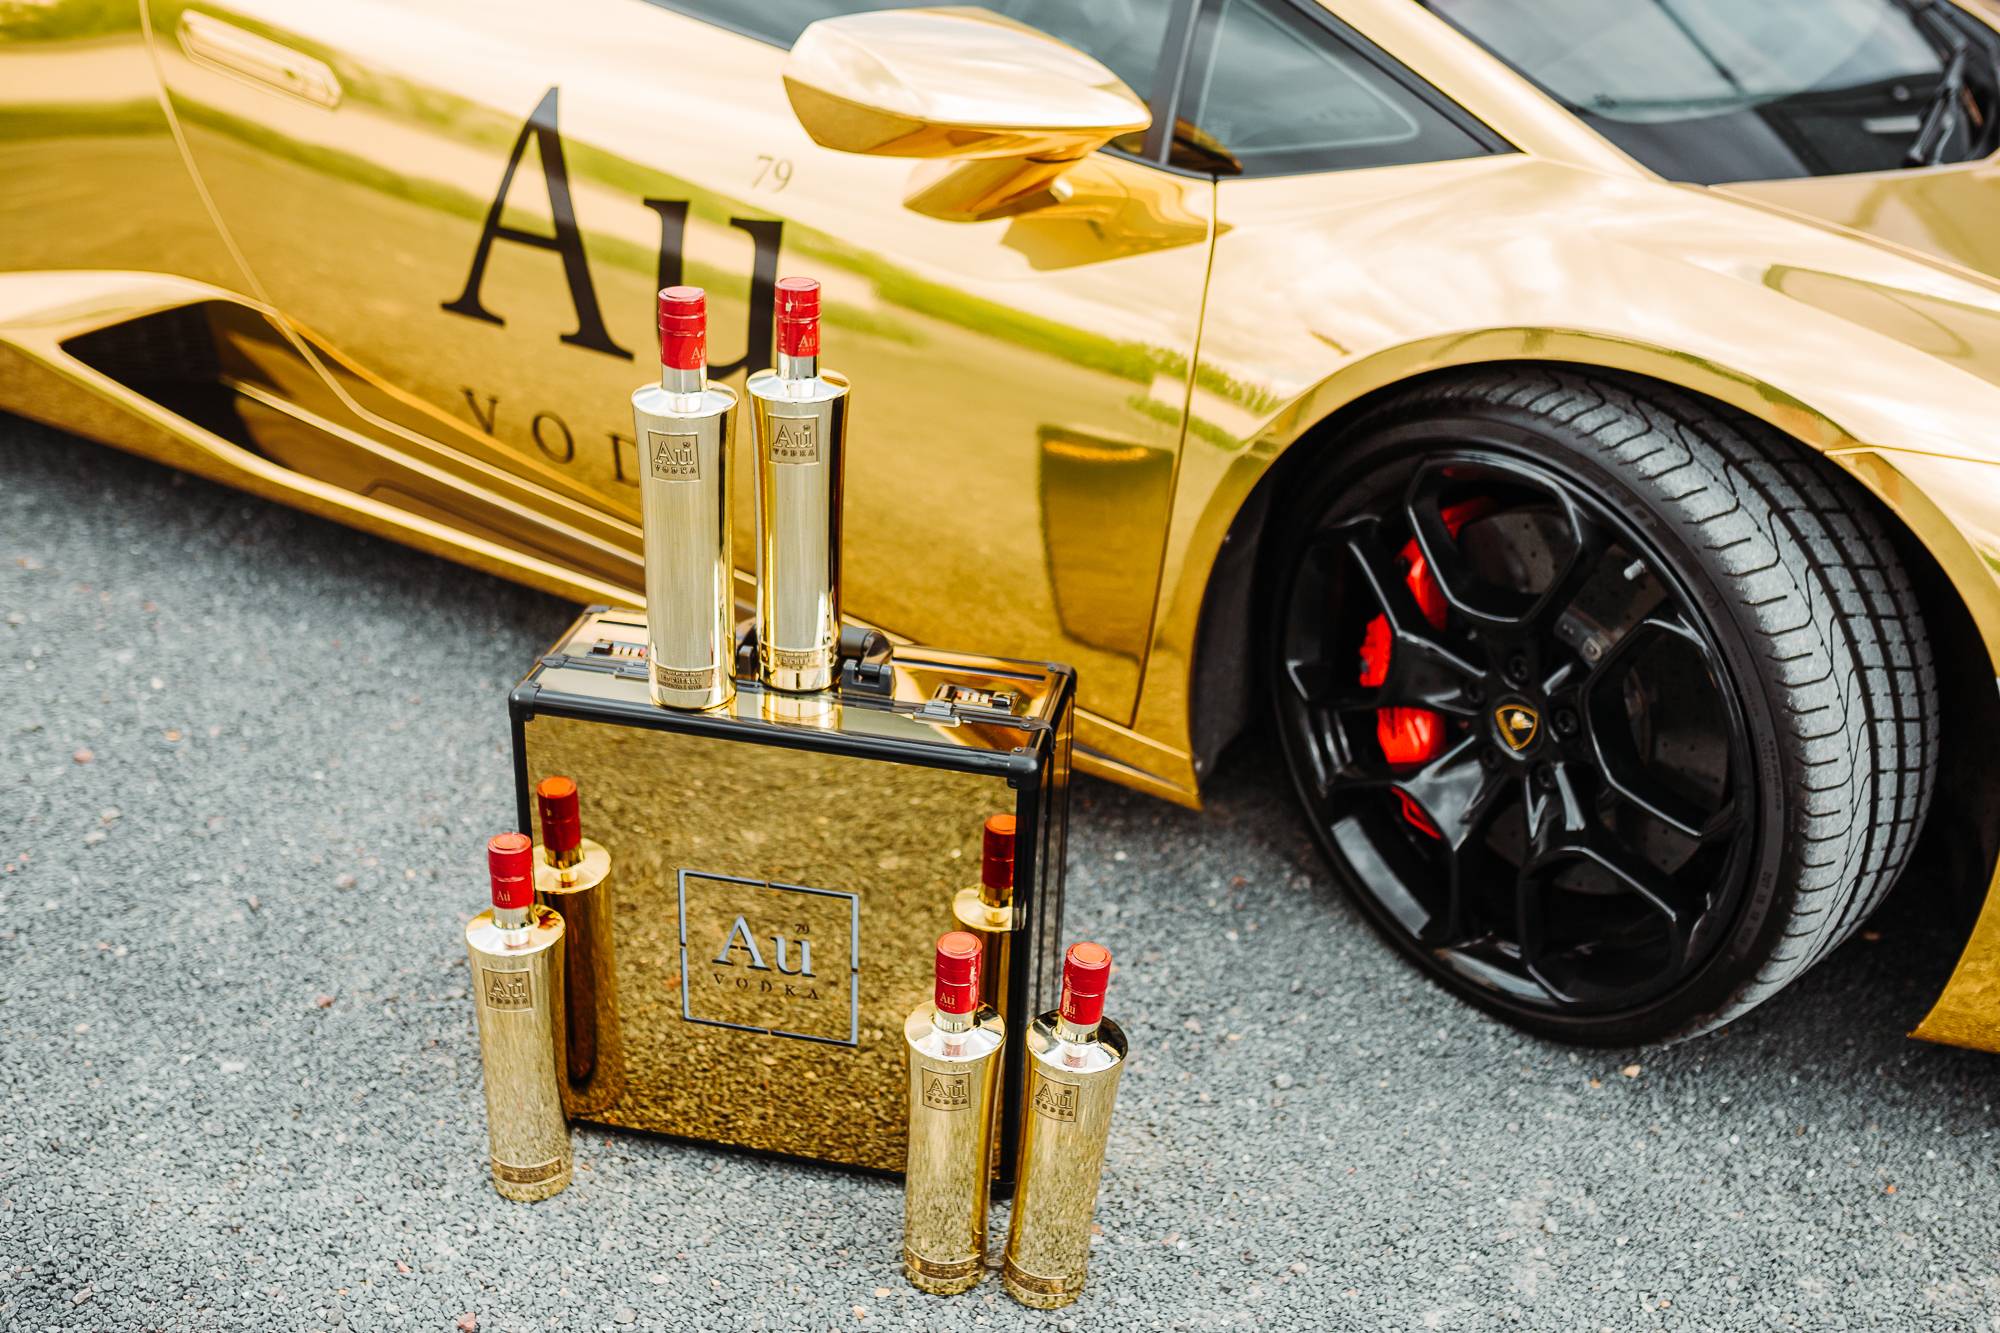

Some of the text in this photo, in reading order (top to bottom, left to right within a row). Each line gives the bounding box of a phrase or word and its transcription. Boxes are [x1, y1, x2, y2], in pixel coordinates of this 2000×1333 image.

[753, 155, 793, 192] 79
[440, 86, 784, 382] Au
[798, 335, 815, 347] Au
[464, 387, 640, 488] VOD
[773, 424, 813, 448] Au
[654, 441, 694, 466] Au
[773, 448, 815, 457] VODKA
[655, 466, 697, 474] VODKA
[497, 890, 511, 902] Au
[795, 923, 810, 934] 79
[712, 915, 816, 978] Au
[488, 977, 526, 998] Au
[712, 973, 819, 1000] VODKA
[939, 992, 955, 1005] Au
[926, 1077, 966, 1098] Au
[1035, 1083, 1074, 1110] Au
[926, 1096, 968, 1105] VODKA
[1036, 1099, 1074, 1117] VODKA
